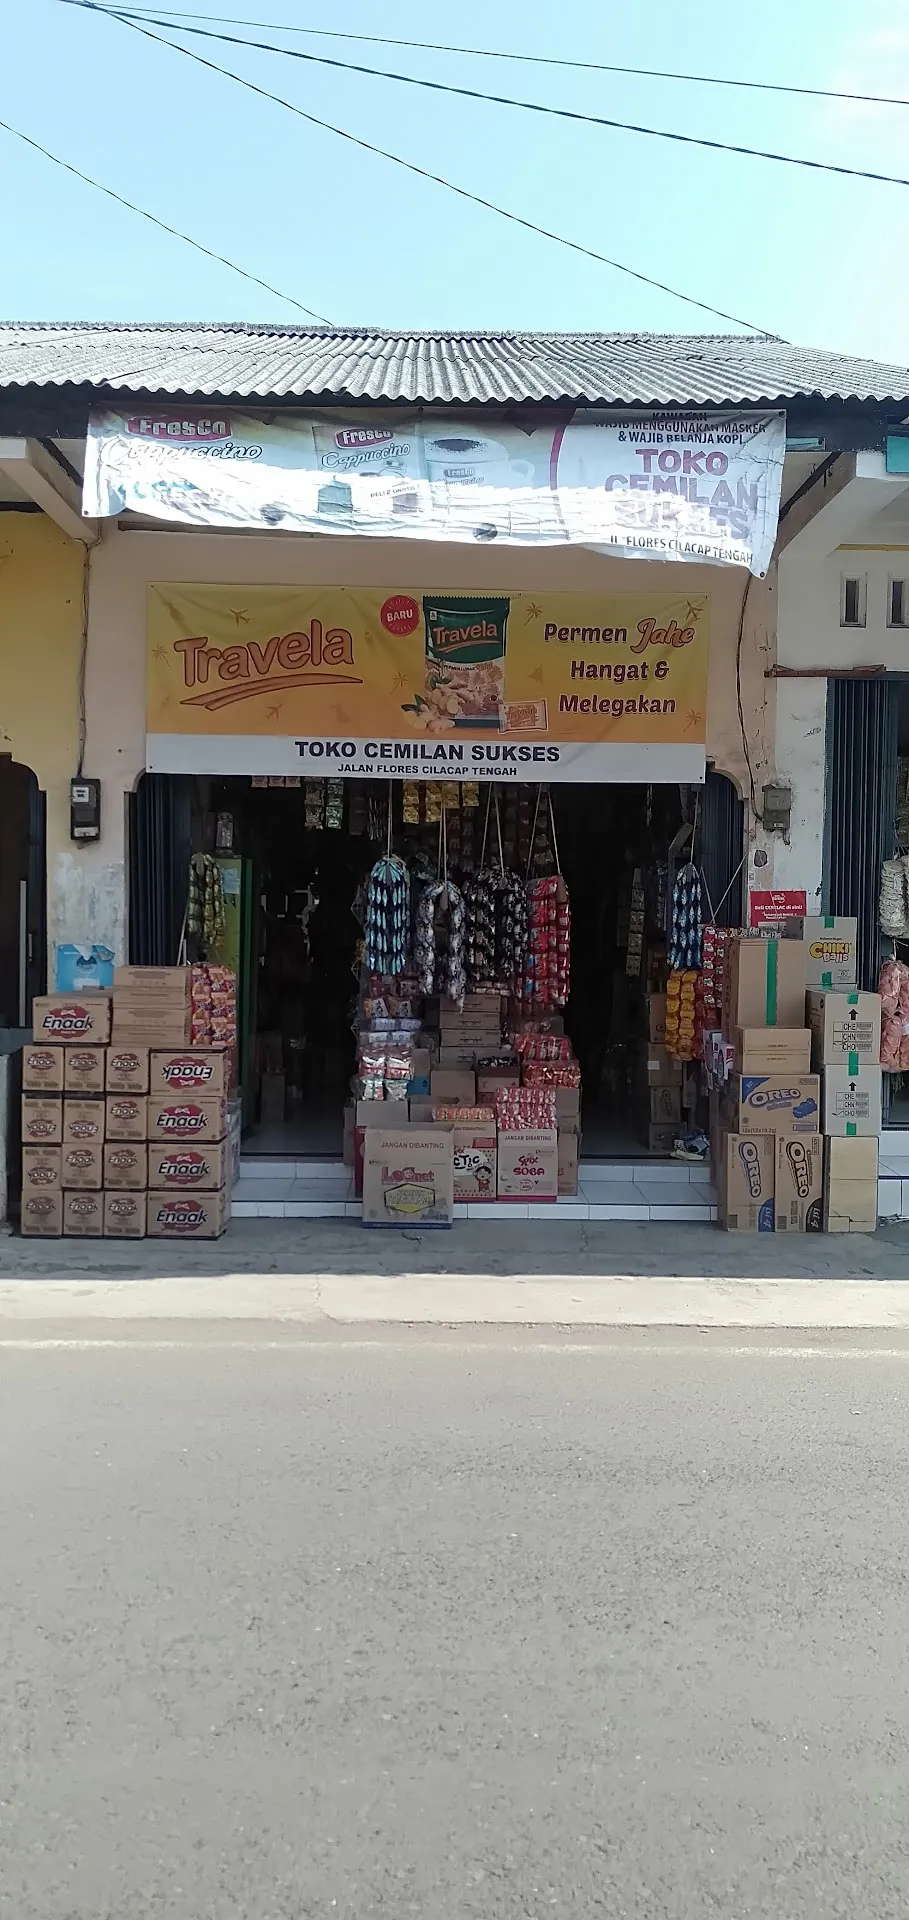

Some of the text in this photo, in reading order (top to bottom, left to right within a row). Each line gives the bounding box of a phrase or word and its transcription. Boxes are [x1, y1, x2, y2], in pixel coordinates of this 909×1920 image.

[632, 420, 719, 434] MENGGUNAKAN
[721, 423, 766, 434] MASKER
[618, 431, 743, 445] & WAJIB BELANJA KOPI
[321, 443, 411, 469] Cappuccino
[635, 449, 729, 476] TOKO
[604, 474, 759, 513] CEMILAN
[625, 535, 667, 549] FLORES
[668, 539, 711, 556] CILACAP
[713, 546, 754, 563] TENGAH
[386, 609, 413, 622] BARU
[432, 620, 498, 645] Travela
[544, 617, 696, 654] Permen Jahe
[174, 619, 354, 687] Travela
[570, 660, 671, 684] Hangat &
[558, 695, 676, 717] Melegakan
[294, 741, 560, 763] TOKO CEMILAN SUKSES
[338, 763, 517, 777] JALAN FLORES CILACAP TENGAH
[809, 942, 850, 959] CHIKI
[822, 952, 849, 964] Balls
[43, 1014, 94, 1030] Enaak
[843, 1023, 856, 1031] CHE
[843, 1033, 856, 1041] CHN
[161, 1065, 214, 1081] Enaak
[749, 1087, 801, 1108] OREO
[157, 1113, 208, 1128] Enaak
[158, 1162, 211, 1176] Enaak
[513, 1167, 545, 1176] SOBA
[738, 1141, 761, 1198] OREO
[786, 1141, 809, 1198] OREO
[156, 1209, 208, 1224] Enaak
